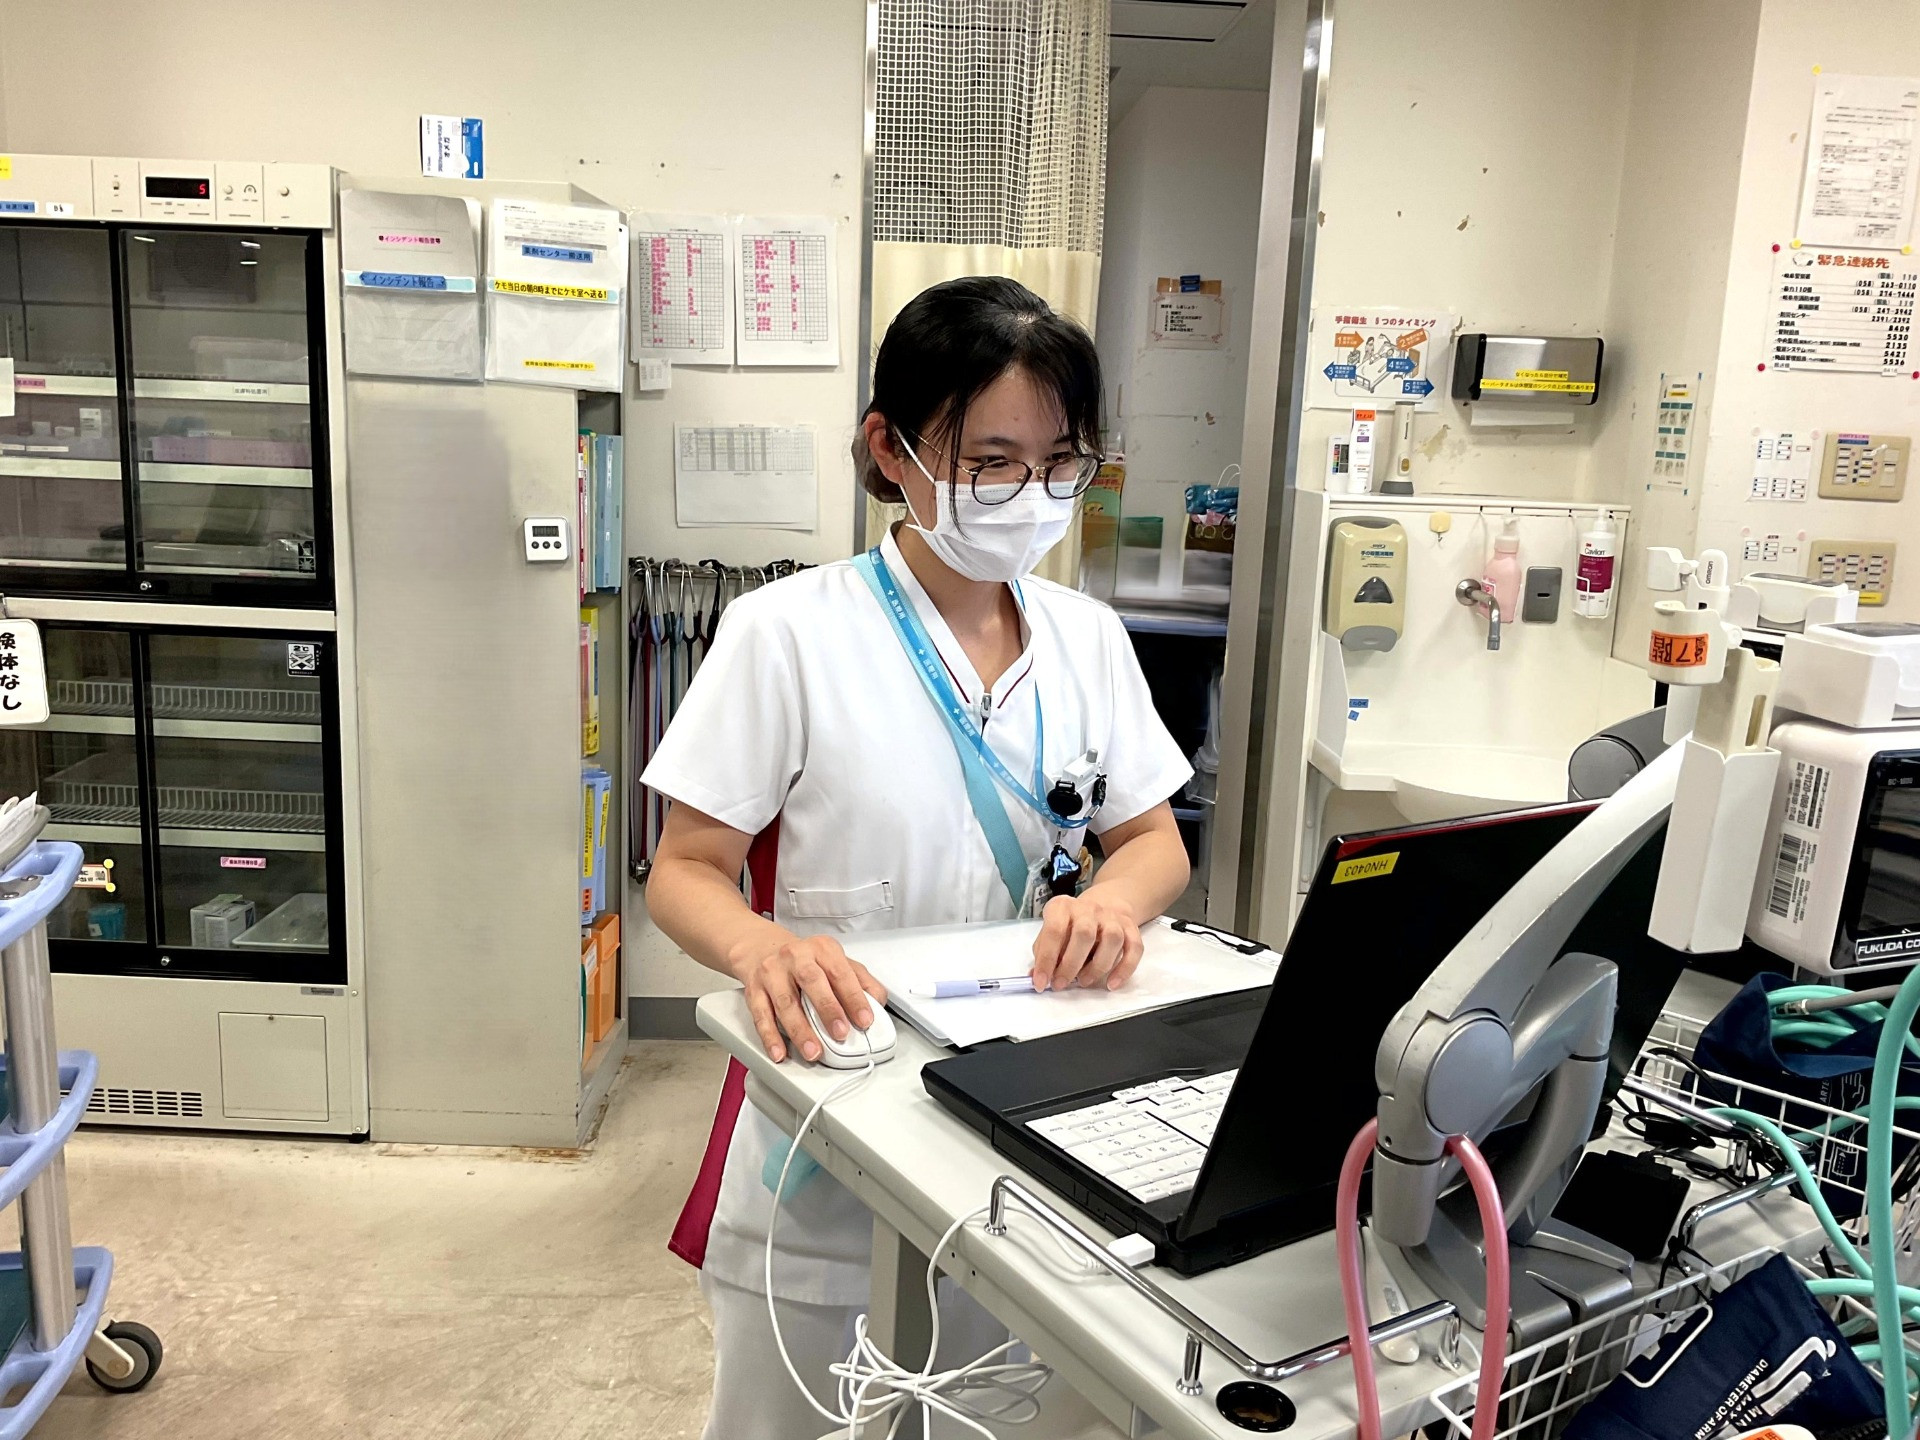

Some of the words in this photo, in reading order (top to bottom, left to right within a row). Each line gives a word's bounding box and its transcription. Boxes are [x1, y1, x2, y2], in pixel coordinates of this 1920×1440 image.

[1817, 254, 1890, 269] 緊急連絡先
[371, 274, 434, 288] インシデント報告
[1337, 336, 1342, 345] 1
[1886, 333, 1909, 341] 5530
[1399, 339, 1407, 348] 2
[1885, 341, 1908, 350] 2135
[1883, 350, 1906, 358] 5421
[1327, 365, 1334, 376] 3
[1388, 360, 1395, 369] 4
[1404, 382, 1412, 392] 5
[1344, 859, 1389, 877] HN0403
[1857, 941, 1903, 956] FUKUDA
[1819, 1079, 1830, 1103] ARTE
[1724, 1358, 1769, 1407] DIAMETER
[1713, 1404, 1727, 1419] OF
[1693, 1415, 1716, 1440] ARM
